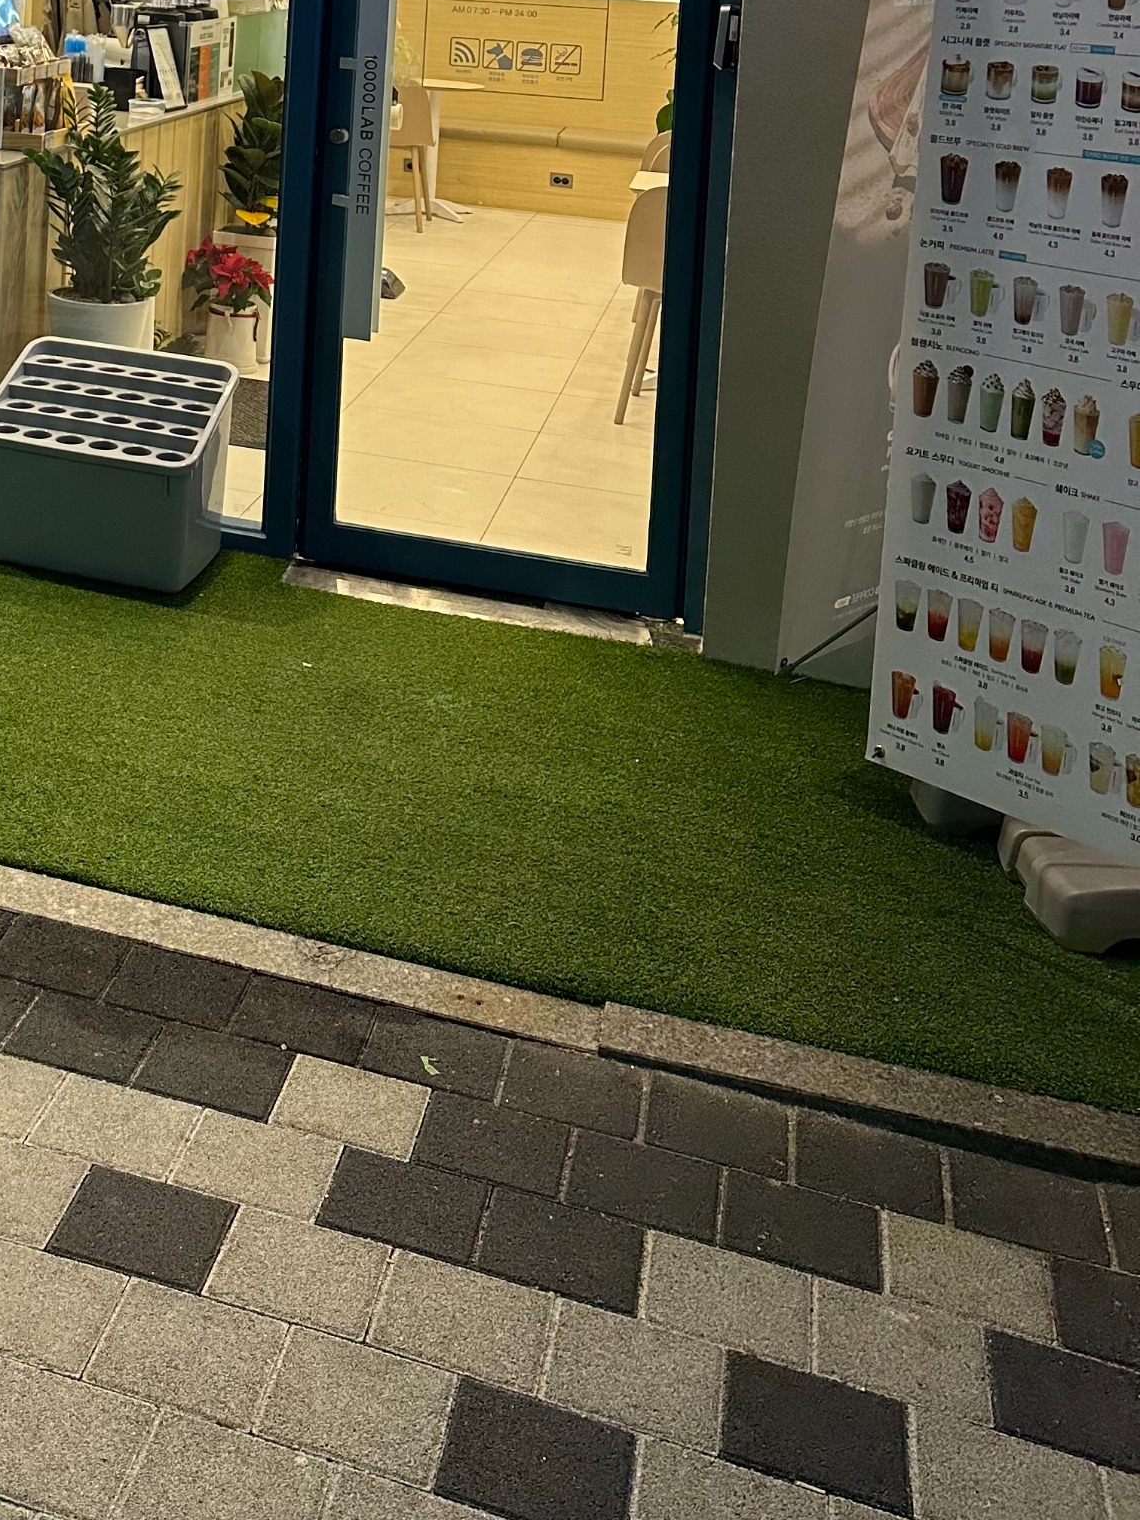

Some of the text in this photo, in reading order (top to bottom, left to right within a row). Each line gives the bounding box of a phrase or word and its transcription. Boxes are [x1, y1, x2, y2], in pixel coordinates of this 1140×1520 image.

[452, 5, 465, 13] AM
[499, 8, 512, 17] PM
[941, 35, 973, 46] 시그니처
[356, 55, 377, 215] 10000LAB COFFEE
[905, 447, 930, 459] 요거트
[932, 452, 954, 465] 스무디
[1081, 492, 1100, 502] SHAKE
[895, 555, 999, 593] 스파클링 에이드 & 프리미엄 티
[1084, 612, 1096, 621] TEA
